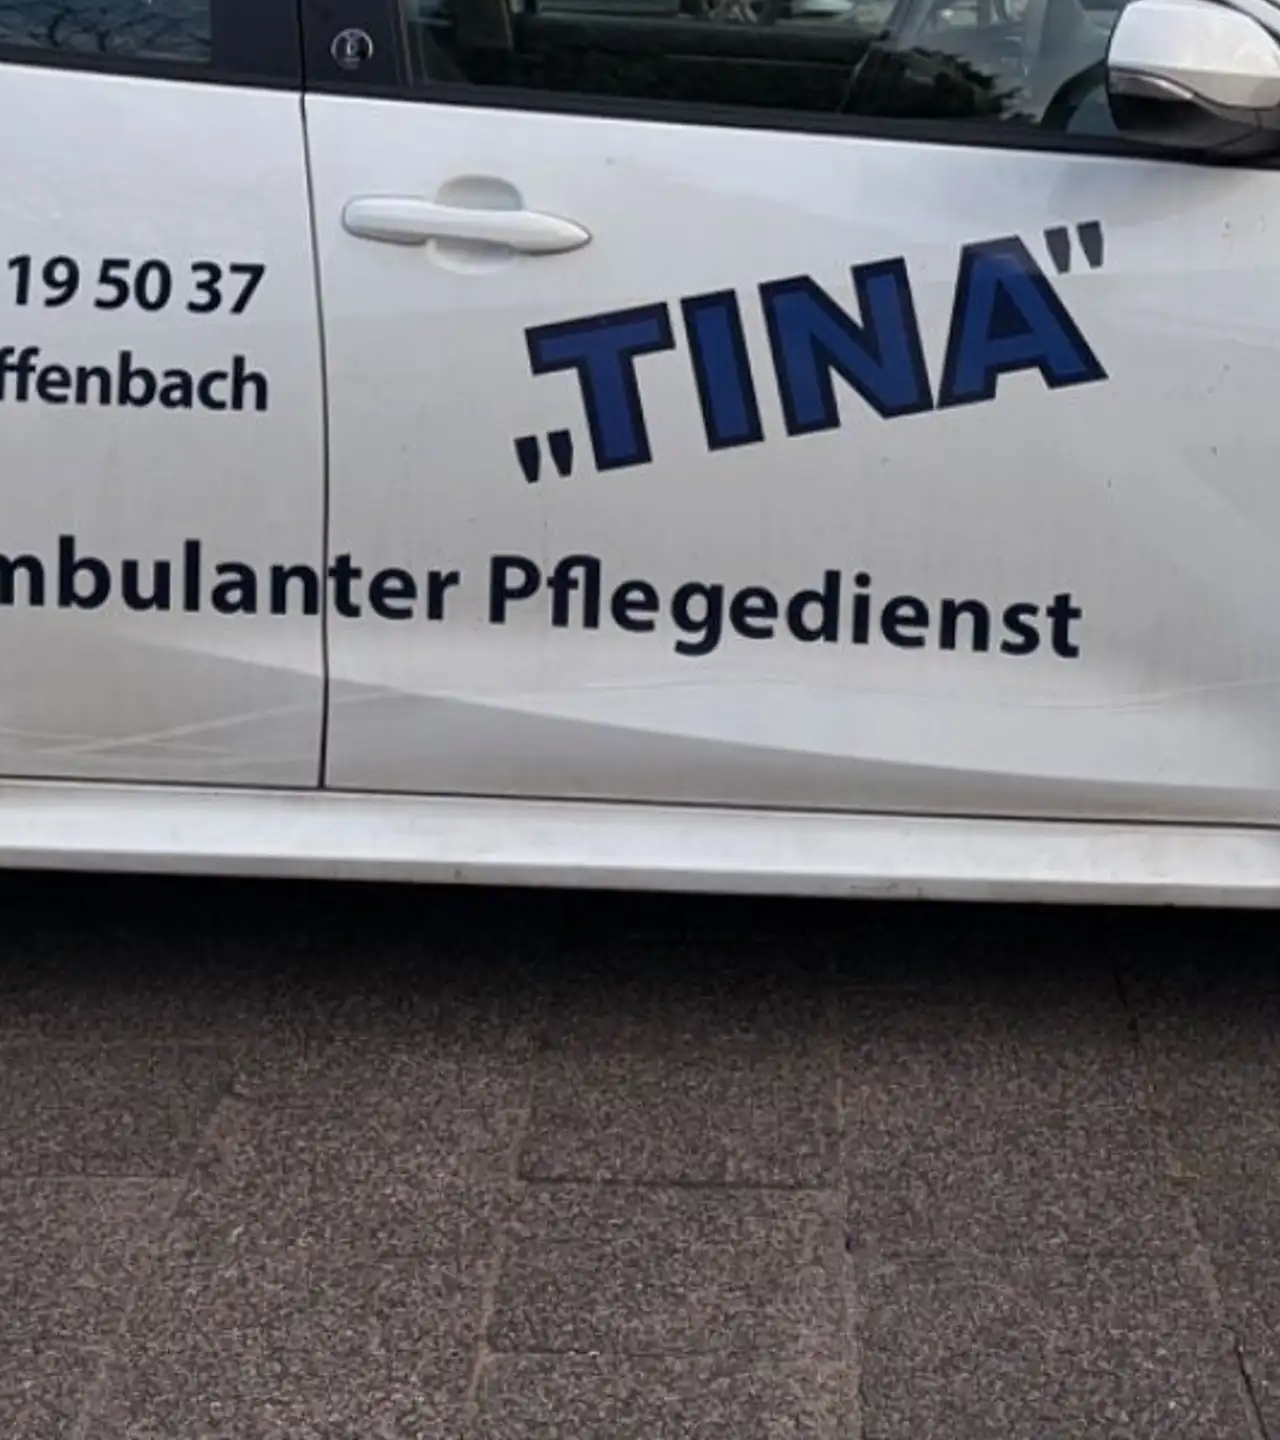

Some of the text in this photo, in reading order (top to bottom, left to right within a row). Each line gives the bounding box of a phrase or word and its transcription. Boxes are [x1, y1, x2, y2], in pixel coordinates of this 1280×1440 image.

[8, 255, 80, 307] 19
[94, 258, 172, 312] 50
[187, 261, 265, 314] 37
[489, 554, 1083, 659] Pflegedienst
